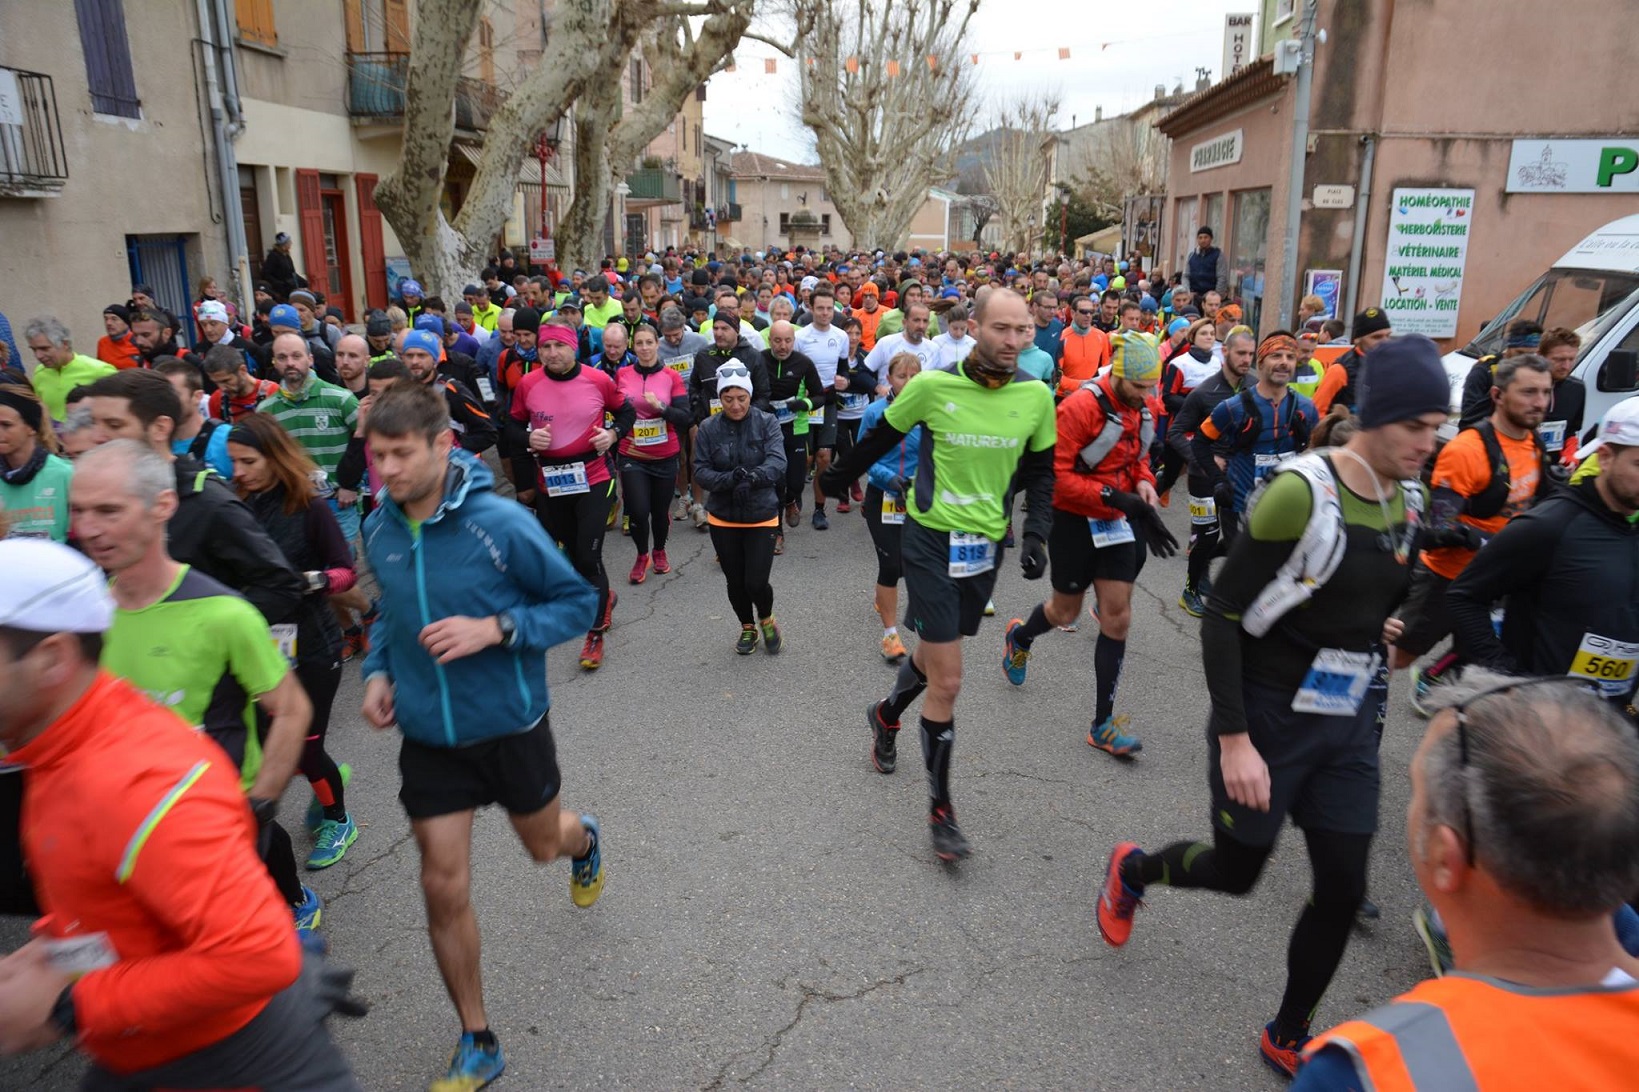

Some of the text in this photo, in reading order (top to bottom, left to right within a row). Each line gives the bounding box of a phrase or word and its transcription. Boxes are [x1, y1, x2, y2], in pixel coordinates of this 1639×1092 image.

[1229, 16, 1251, 26] BAR
[1400, 193, 1471, 208] HOMÉOPATHIE
[1400, 223, 1467, 235] HERBORISTERIE
[1398, 243, 1459, 258] VÉTÉRINAIRE
[1389, 263, 1461, 278] MATÉRIEL MÉDICAL
[1384, 298, 1427, 310] LOCATION
[1435, 299, 1458, 310] VENTE
[638, 427, 655, 437] 207
[946, 433, 1009, 448] NATUREX
[548, 473, 576, 487] 1013
[1584, 657, 1628, 678] 560
